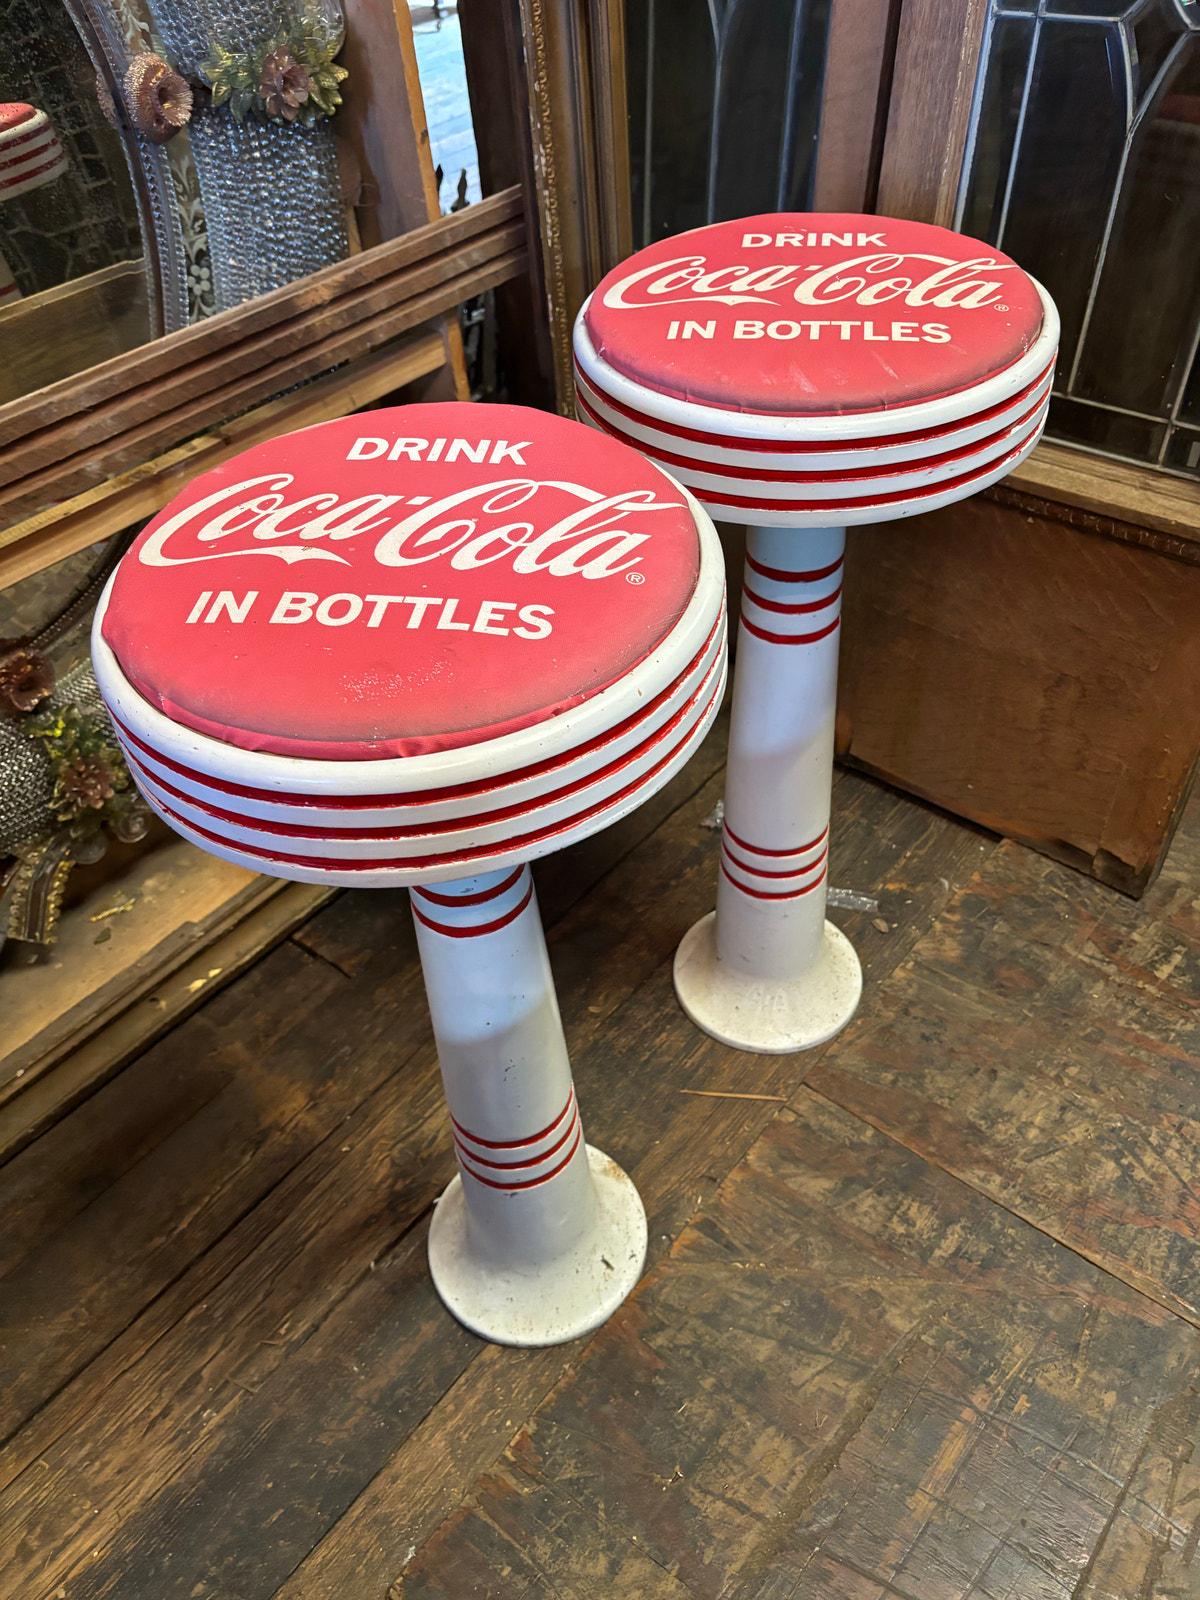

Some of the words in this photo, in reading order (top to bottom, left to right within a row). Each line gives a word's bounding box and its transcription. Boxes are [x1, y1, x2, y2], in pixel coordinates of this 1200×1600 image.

[741, 232, 888, 248] DRINK
[602, 254, 1020, 310] Coca-Cola
[666, 320, 717, 341] IN
[733, 319, 952, 344] BOTTLES
[346, 437, 533, 466] DRINK
[138, 473, 688, 580] Coca-Cola
[186, 590, 260, 626] IN
[269, 592, 556, 641] BOTTLES
